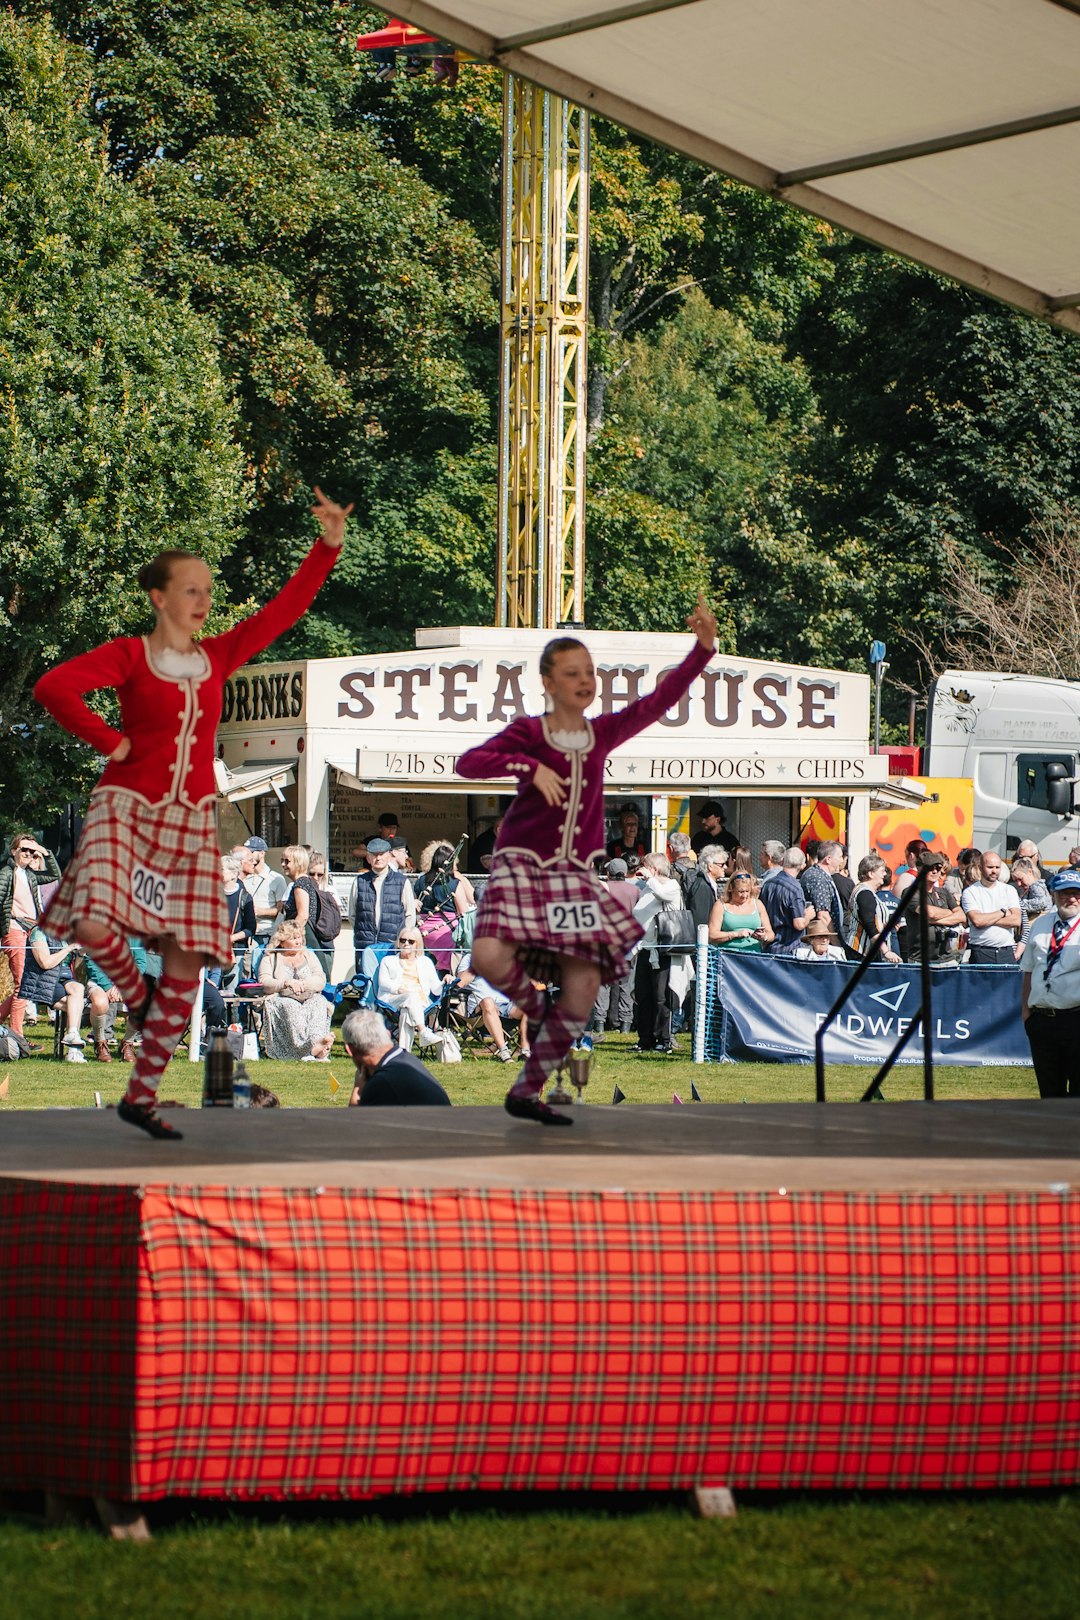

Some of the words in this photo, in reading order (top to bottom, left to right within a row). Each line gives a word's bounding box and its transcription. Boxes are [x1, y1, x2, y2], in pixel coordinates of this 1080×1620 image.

[220, 671, 304, 724] DRINKS
[338, 660, 840, 729] STEAHOUSE
[649, 758, 765, 779] HOTDOGS
[797, 759, 864, 779] CHIPS
[134, 869, 166, 911] 206
[553, 904, 596, 929] 215
[853, 1054, 887, 1064] Property
